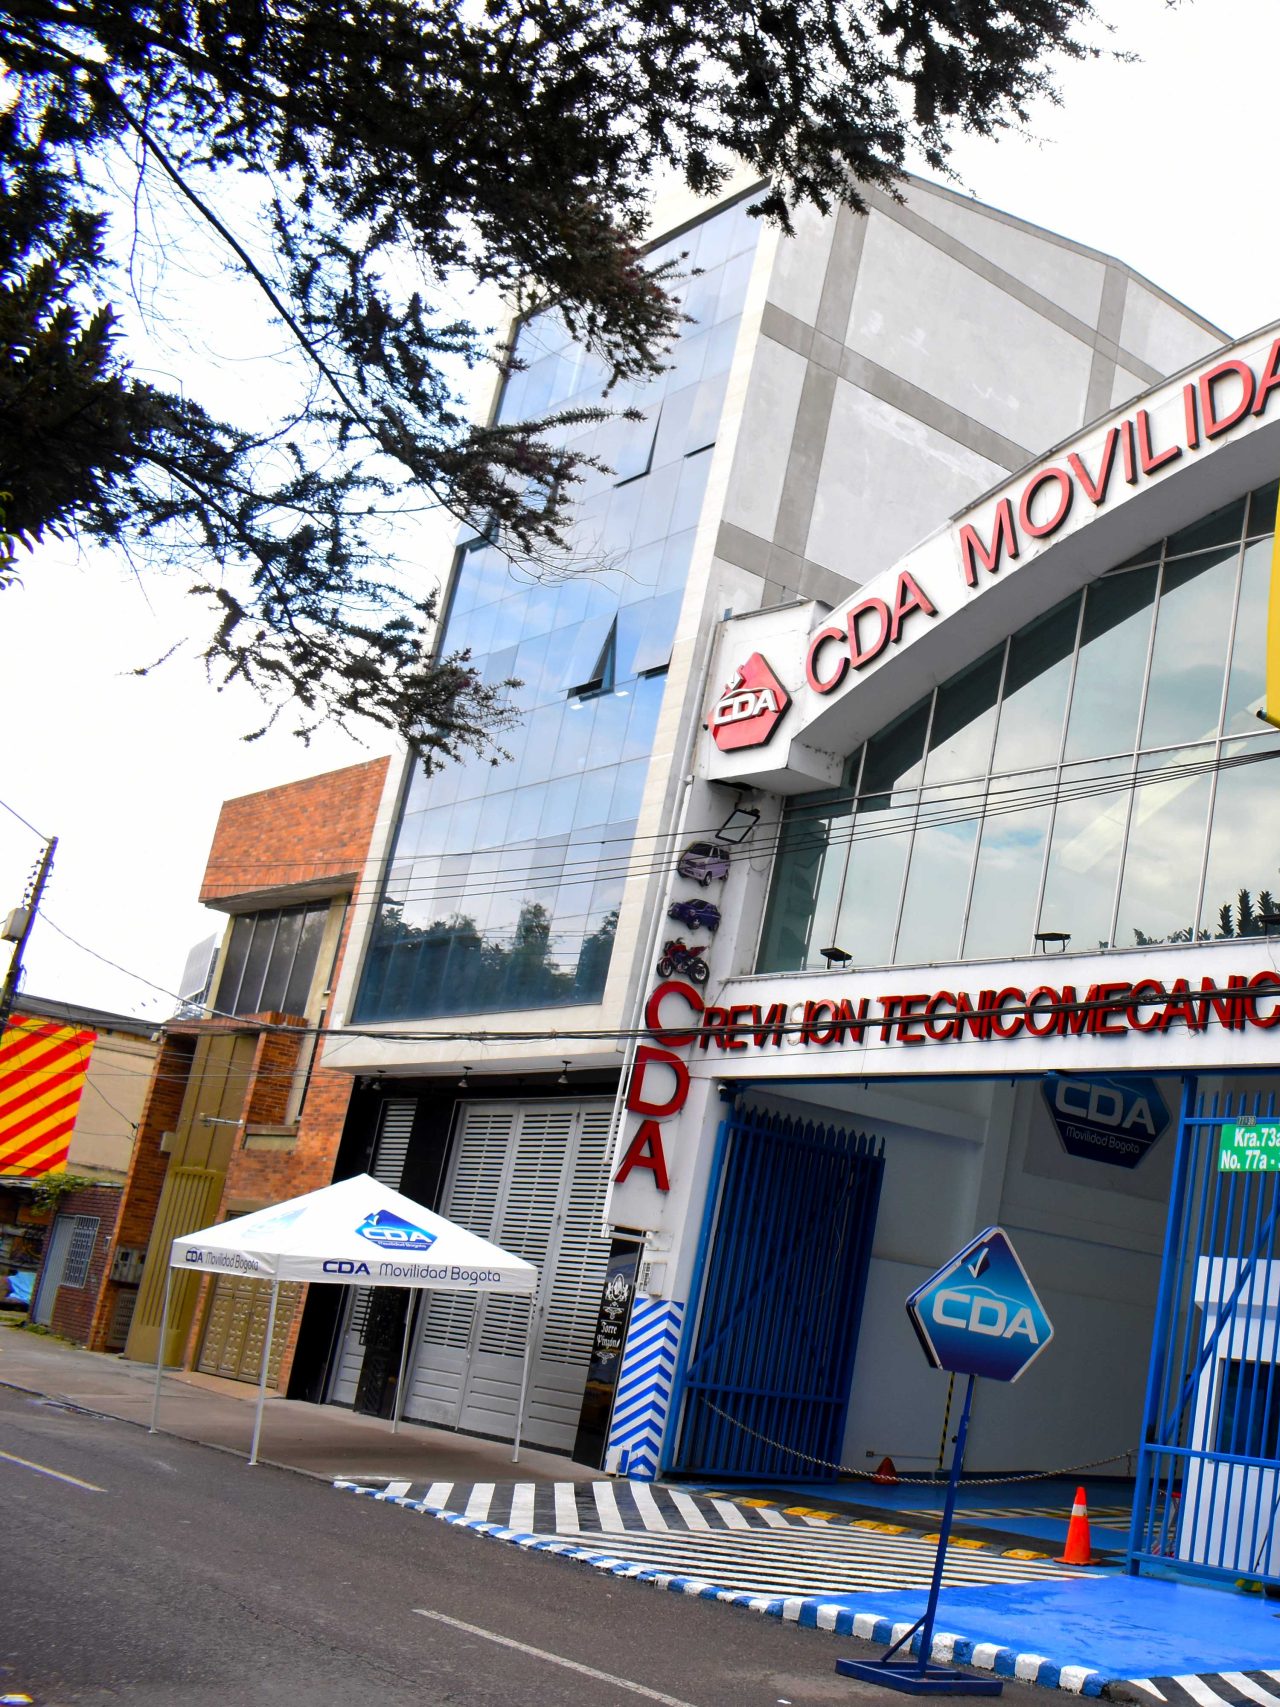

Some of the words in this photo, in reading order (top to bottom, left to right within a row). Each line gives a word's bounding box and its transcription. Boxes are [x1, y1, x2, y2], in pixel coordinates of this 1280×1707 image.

[805, 571, 938, 695] CDA
[714, 689, 779, 727] CDA
[614, 980, 704, 1192] CDA
[1055, 1079, 1156, 1136] CDA
[1066, 1125, 1108, 1147] Movilidad
[1220, 1149, 1241, 1170] No.
[1245, 1149, 1268, 1170] 77a
[362, 1228, 433, 1243] CDA
[185, 1250, 203, 1263] CDA
[205, 1251, 234, 1267] Movilidad
[235, 1253, 259, 1273] Bogota
[322, 1260, 371, 1276] CDA
[379, 1263, 448, 1281] Movilidad
[450, 1266, 501, 1286] Bogota
[932, 1289, 1039, 1344] CDA
